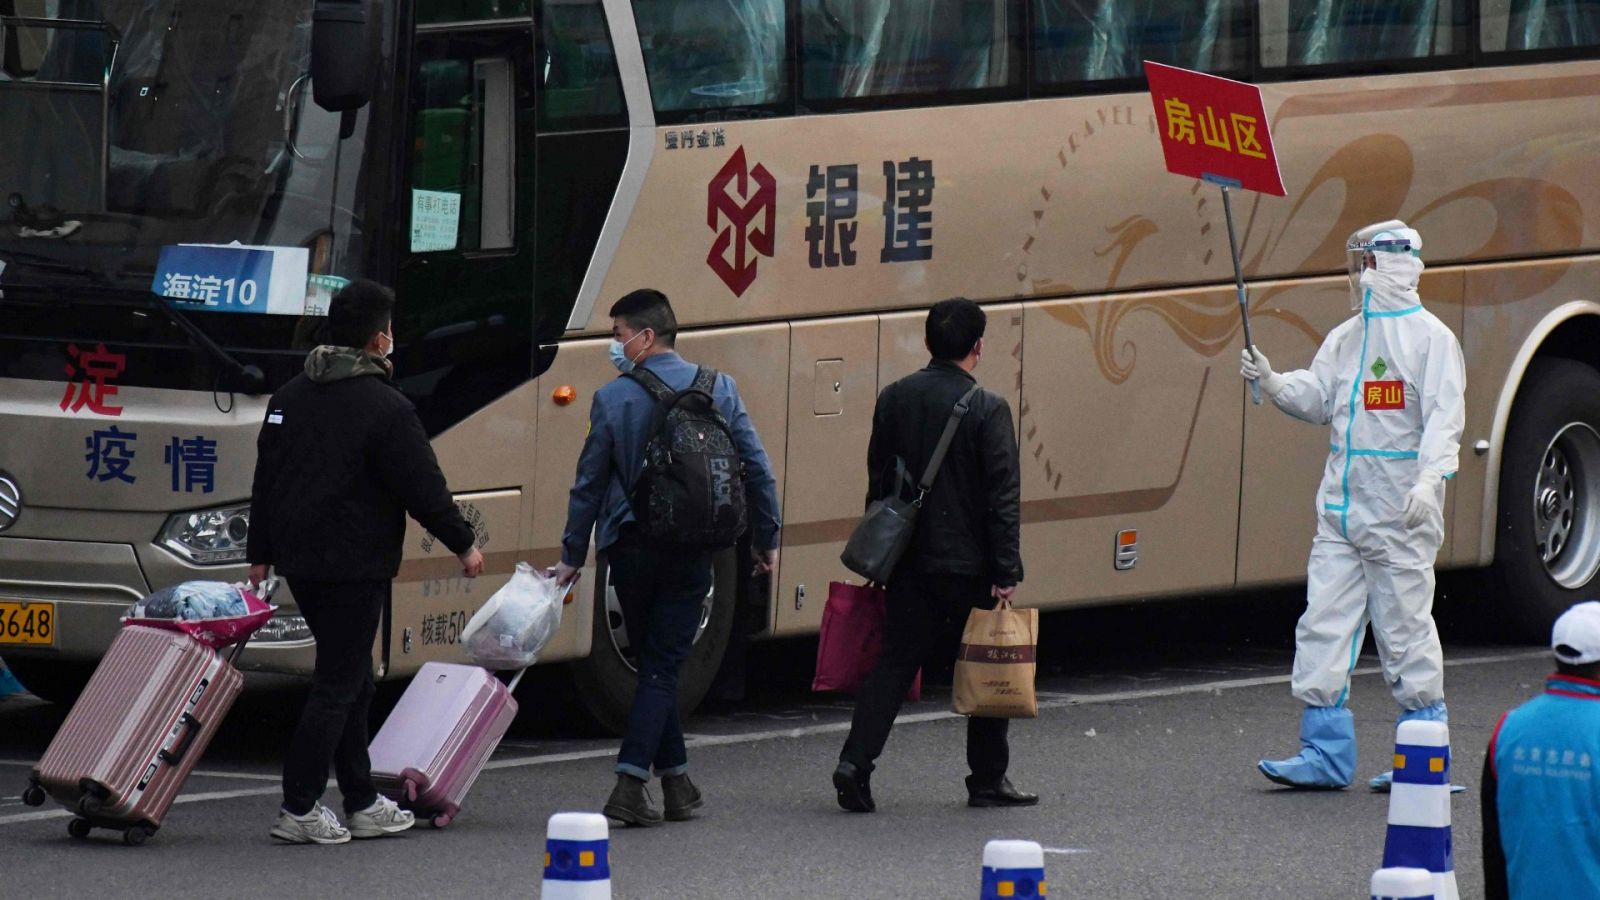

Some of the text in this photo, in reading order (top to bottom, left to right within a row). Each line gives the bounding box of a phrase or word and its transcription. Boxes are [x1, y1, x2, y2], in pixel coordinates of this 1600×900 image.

[1056, 105, 1137, 168] TRAVEL
[1164, 97, 1267, 159] 房山区
[416, 194, 457, 216] 有事打电话
[804, 156, 935, 269] 银建
[162, 272, 257, 306] 海淀10
[59, 342, 126, 416] 淀
[1366, 386, 1402, 405] 房山
[85, 425, 218, 493] 疫情
